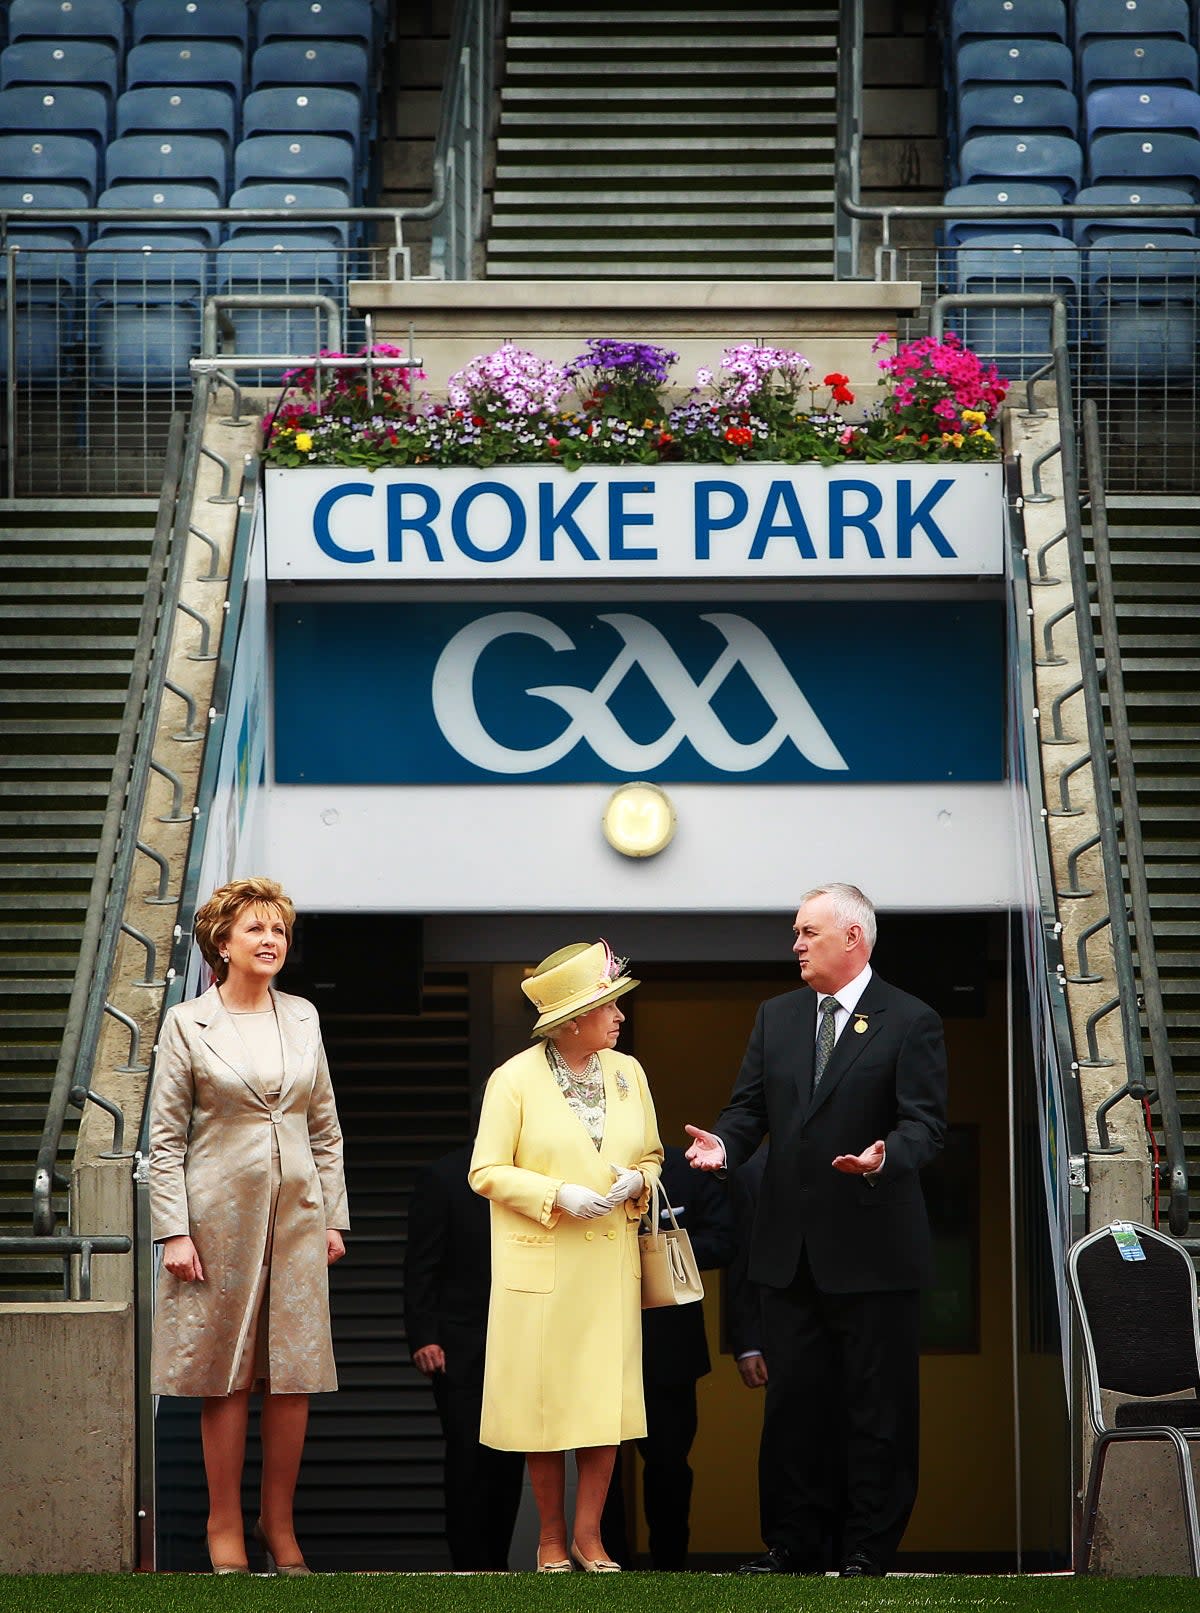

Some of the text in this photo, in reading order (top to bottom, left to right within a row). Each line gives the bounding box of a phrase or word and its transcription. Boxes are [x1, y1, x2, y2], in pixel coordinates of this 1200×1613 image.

[313, 479, 958, 563] CROKE PARK
[431, 611, 849, 774] GAA
